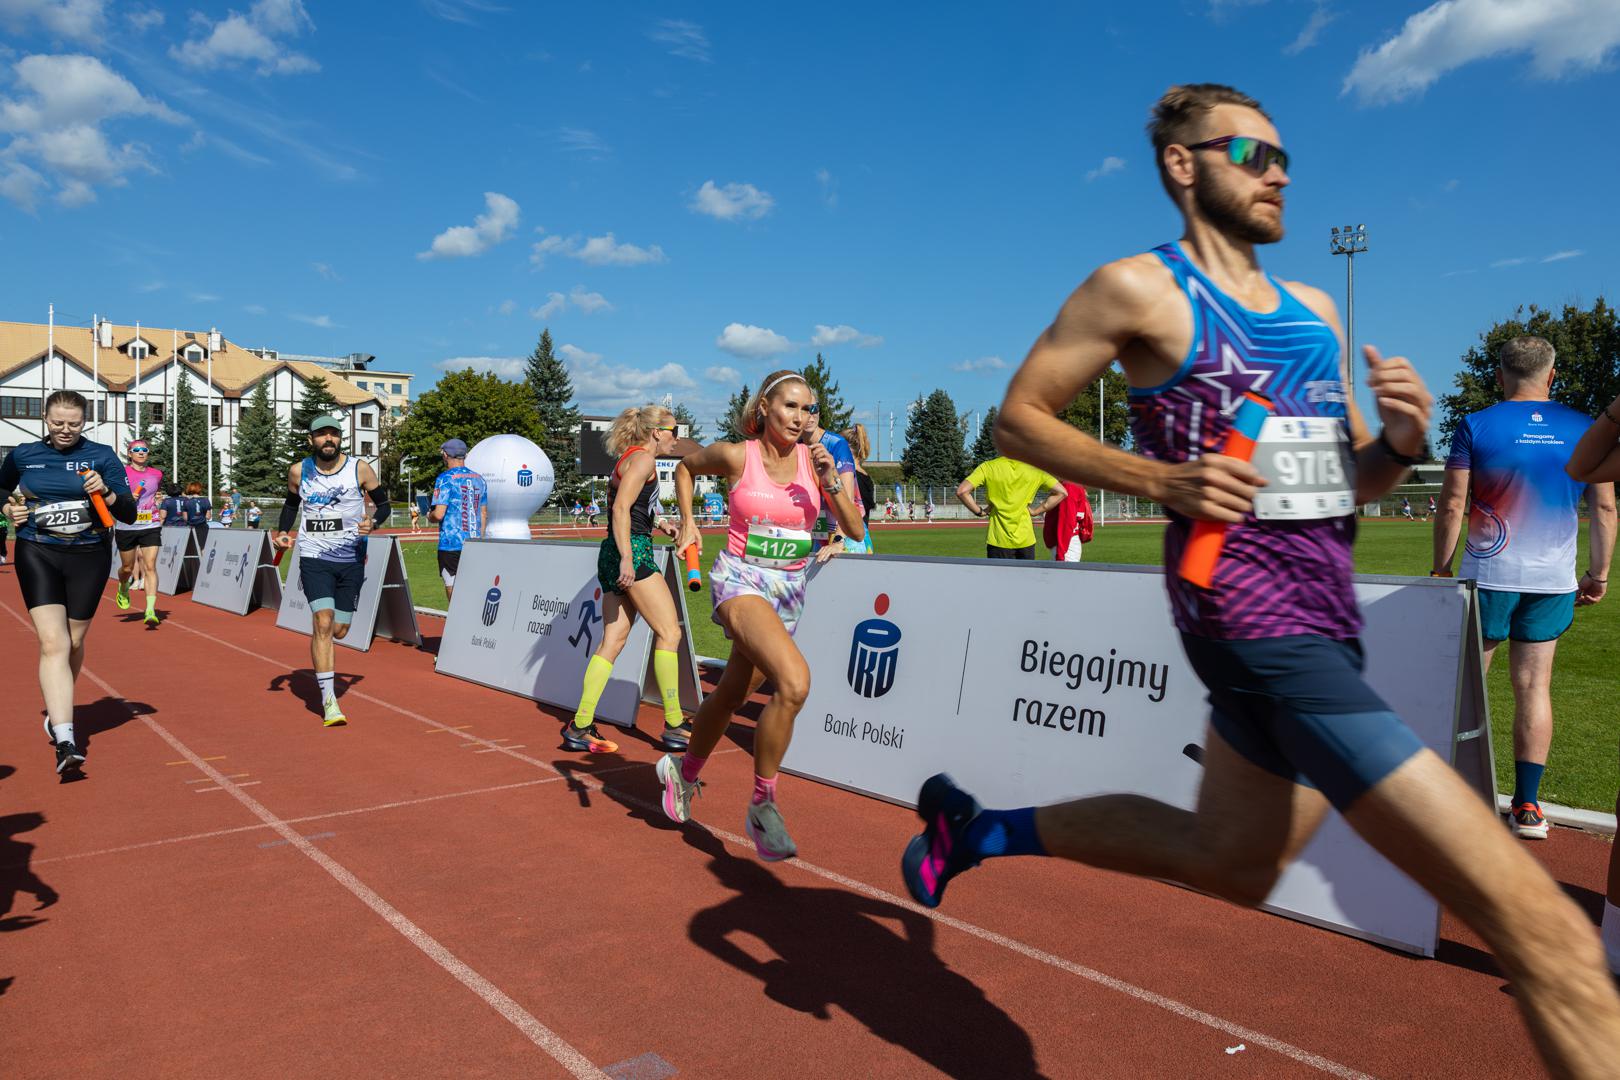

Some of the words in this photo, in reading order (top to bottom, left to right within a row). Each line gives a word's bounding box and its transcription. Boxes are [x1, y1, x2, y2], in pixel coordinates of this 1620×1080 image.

[66, 461, 89, 471] EIS
[45, 511, 80, 526] 22/5
[311, 521, 336, 531] 71/2
[760, 541, 798, 557] 11/2
[532, 594, 570, 620] Biegajmy
[526, 620, 553, 636] razem
[1020, 639, 1169, 703] Biegajmy
[1012, 697, 1107, 738] razem
[824, 713, 858, 739] Bank
[862, 721, 905, 749] Polski
